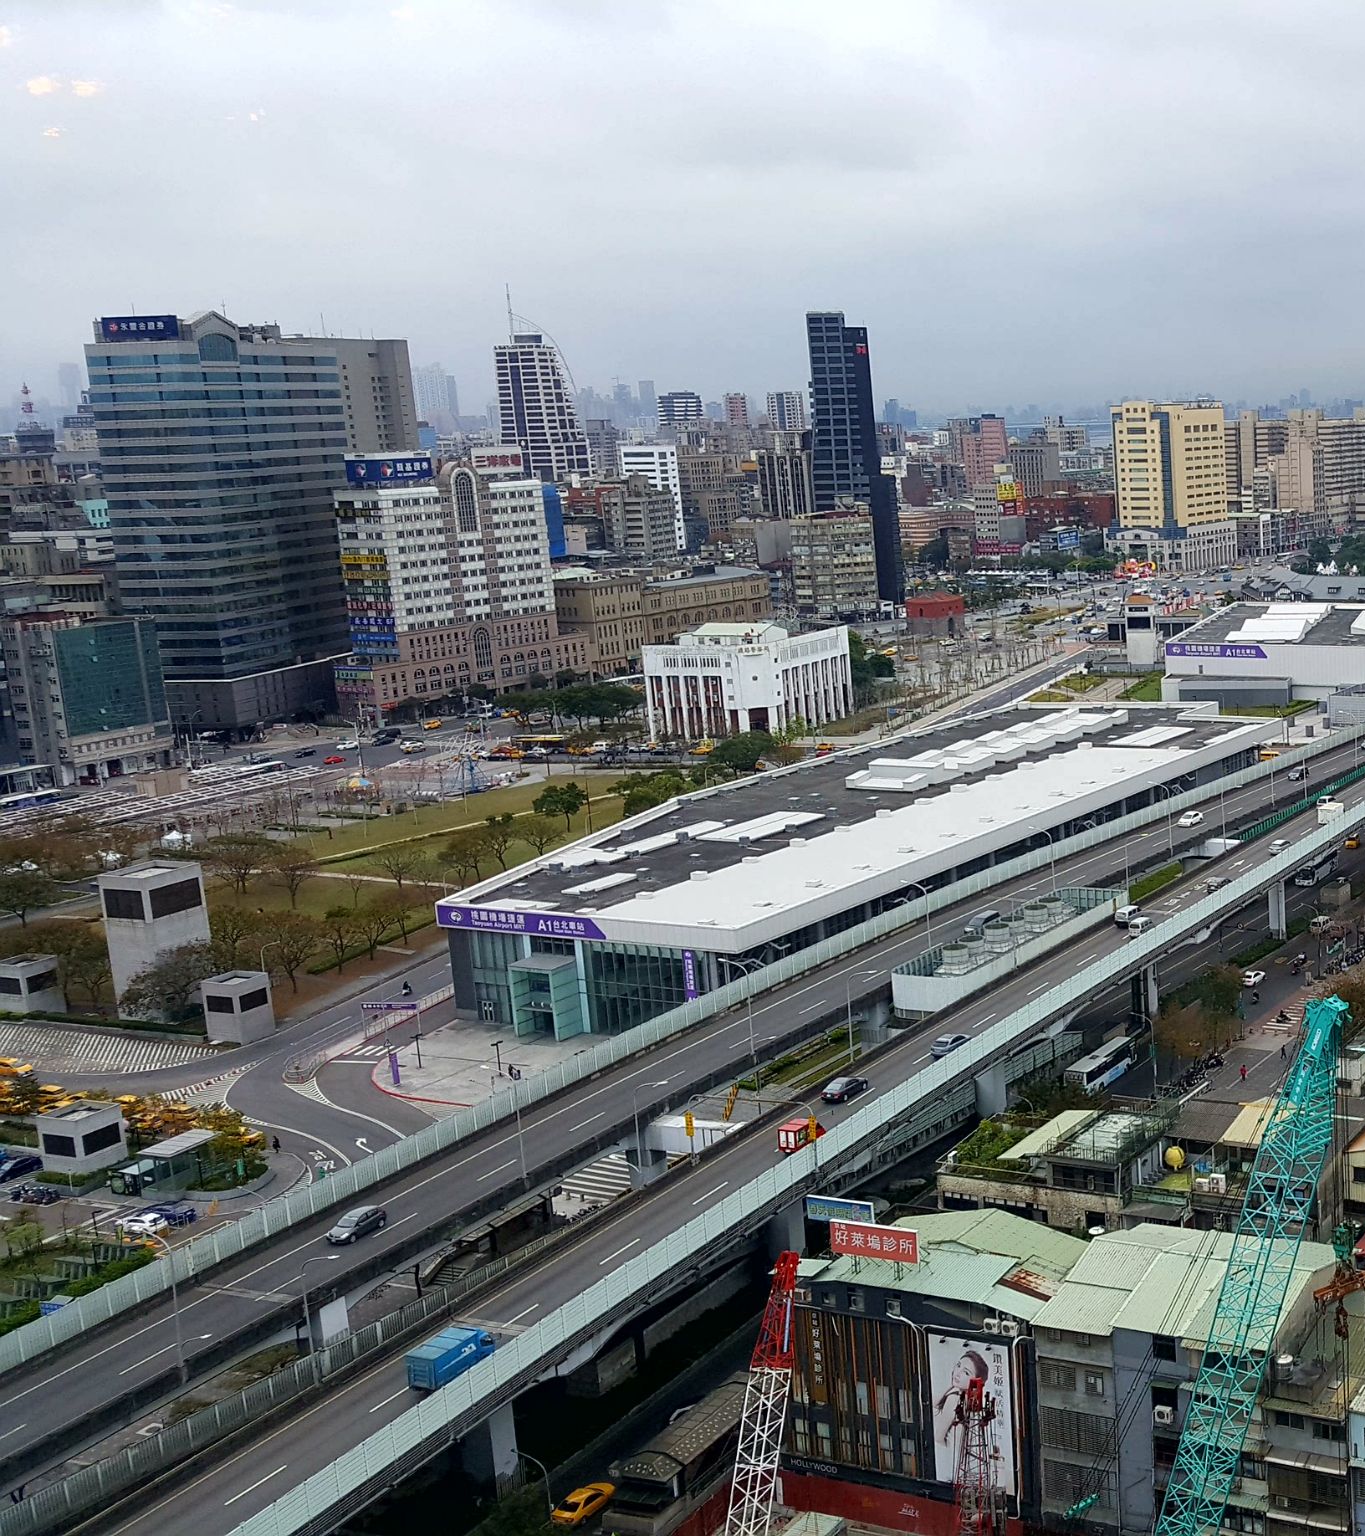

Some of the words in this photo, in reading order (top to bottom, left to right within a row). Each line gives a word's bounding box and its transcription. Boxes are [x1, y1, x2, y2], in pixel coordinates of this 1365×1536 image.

[1226, 648, 1236, 657] A1
[470, 910, 525, 924] 桃園機場捷運
[471, 920, 493, 929] Taoyuan
[493, 922, 513, 930] Airport
[538, 919, 553, 932] A1
[553, 919, 585, 931] 台北車站
[790, 1458, 838, 1474] HOLLYWOOD
